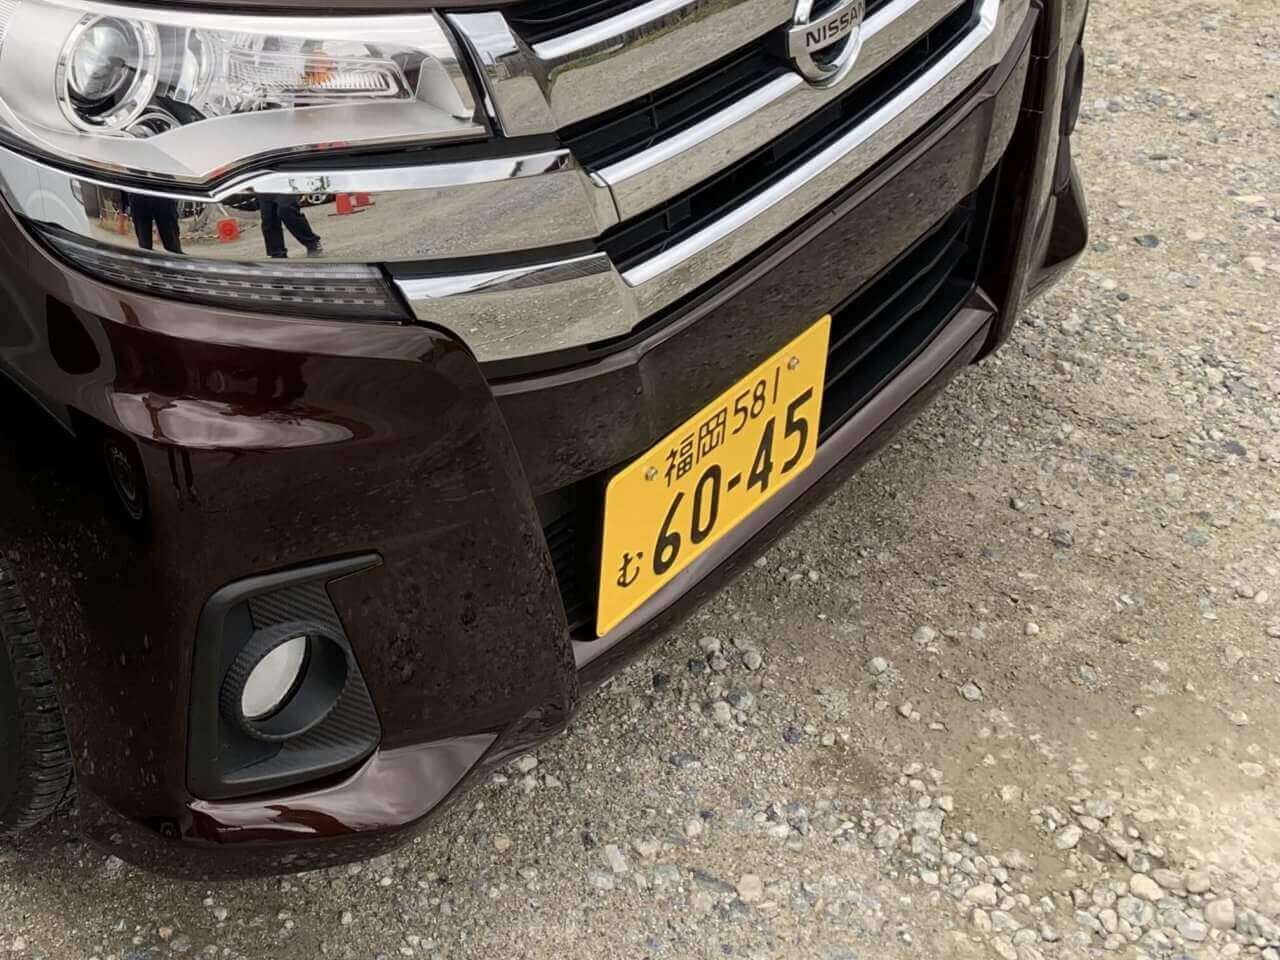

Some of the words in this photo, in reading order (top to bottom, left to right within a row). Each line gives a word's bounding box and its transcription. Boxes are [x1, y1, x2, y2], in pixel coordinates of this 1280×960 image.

[617, 551, 644, 589] む
[652, 386, 814, 576] 60-45
[665, 407, 728, 487] 福岡
[732, 366, 780, 436] 581
